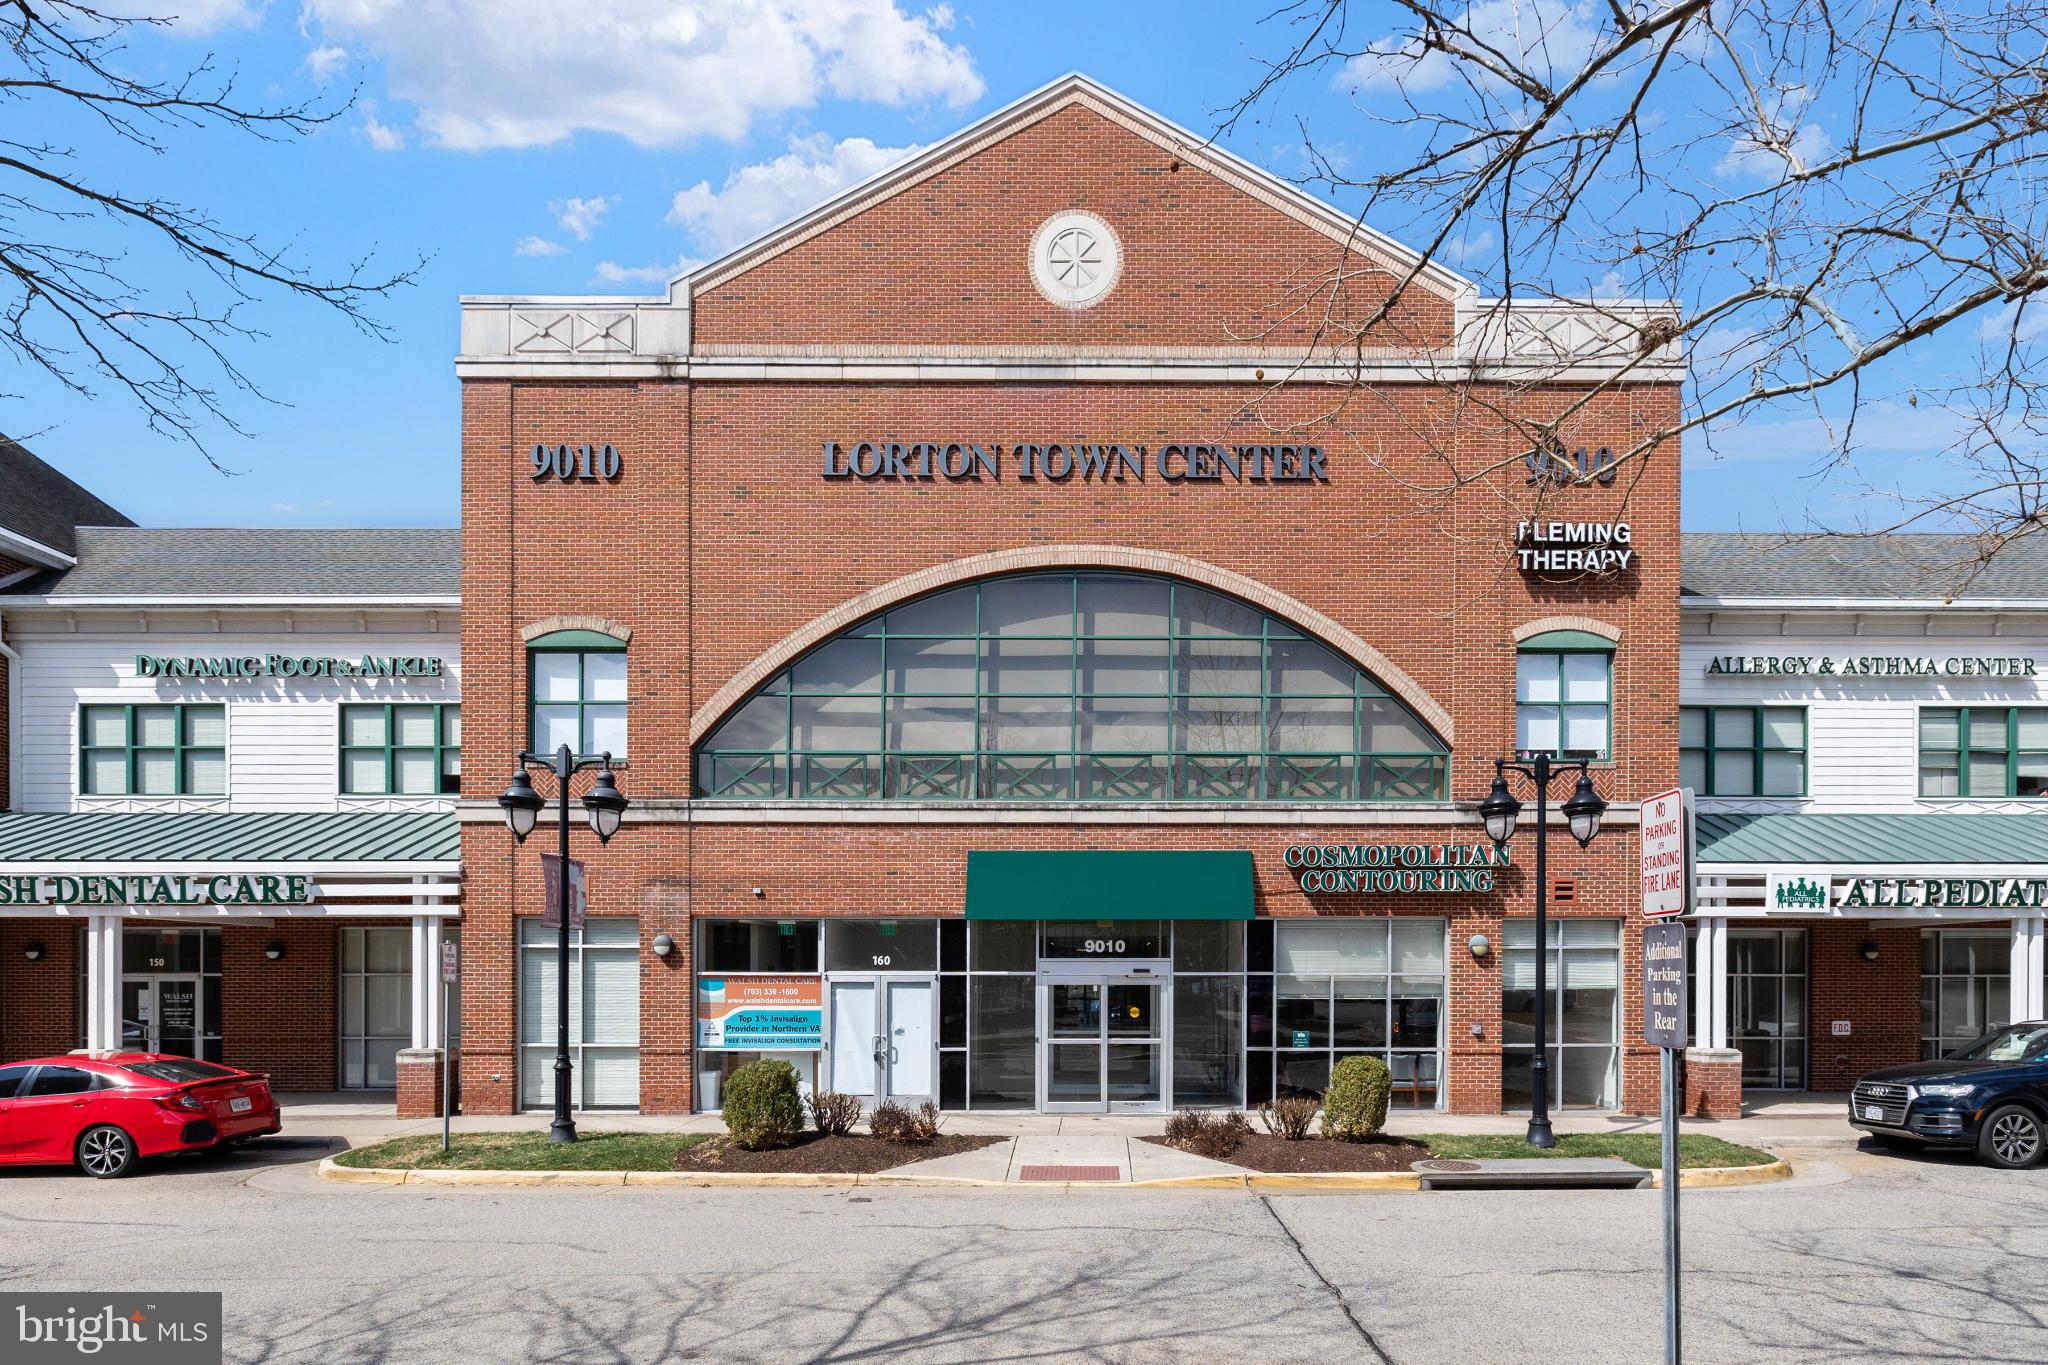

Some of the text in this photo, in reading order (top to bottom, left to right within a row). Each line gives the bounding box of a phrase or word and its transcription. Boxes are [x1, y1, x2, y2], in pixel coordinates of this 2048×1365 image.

[530, 443, 620, 479] 9010
[821, 443, 1329, 480] LORTON TOWN CENTER
[1518, 521, 1632, 543] FLEMING
[1517, 548, 1633, 571] THERAPY
[134, 653, 440, 677] DYNAMIC FOOT & ANKLE
[1708, 655, 2039, 676] ALLERGY & ASTHMA CENTER
[1655, 802, 1666, 819] NO
[1645, 820, 1677, 841] PARKING
[1283, 844, 1513, 867] COSMOPOLITAN
[1657, 841, 1665, 850] OR
[1644, 850, 1680, 871] STANDING
[53, 875, 201, 905] DENTAL
[208, 875, 310, 905] CARE
[1301, 869, 1495, 893] CONTOURING
[1643, 870, 1681, 894] FIRE LANE
[1845, 879, 1915, 908] ALL
[1084, 939, 1126, 953] 9010
[1645, 940, 1682, 960] Additional
[149, 958, 165, 967] 150
[872, 955, 891, 966] 160
[728, 977, 817, 985] WALSH DENTAL CARE
[1647, 967, 1681, 985] Parking
[743, 988, 762, 996] (703)
[1652, 987, 1678, 1006] in the
[738, 1015, 752, 1023] Top
[771, 1015, 808, 1023] Invisalign
[1654, 1011, 1677, 1031] Rear
